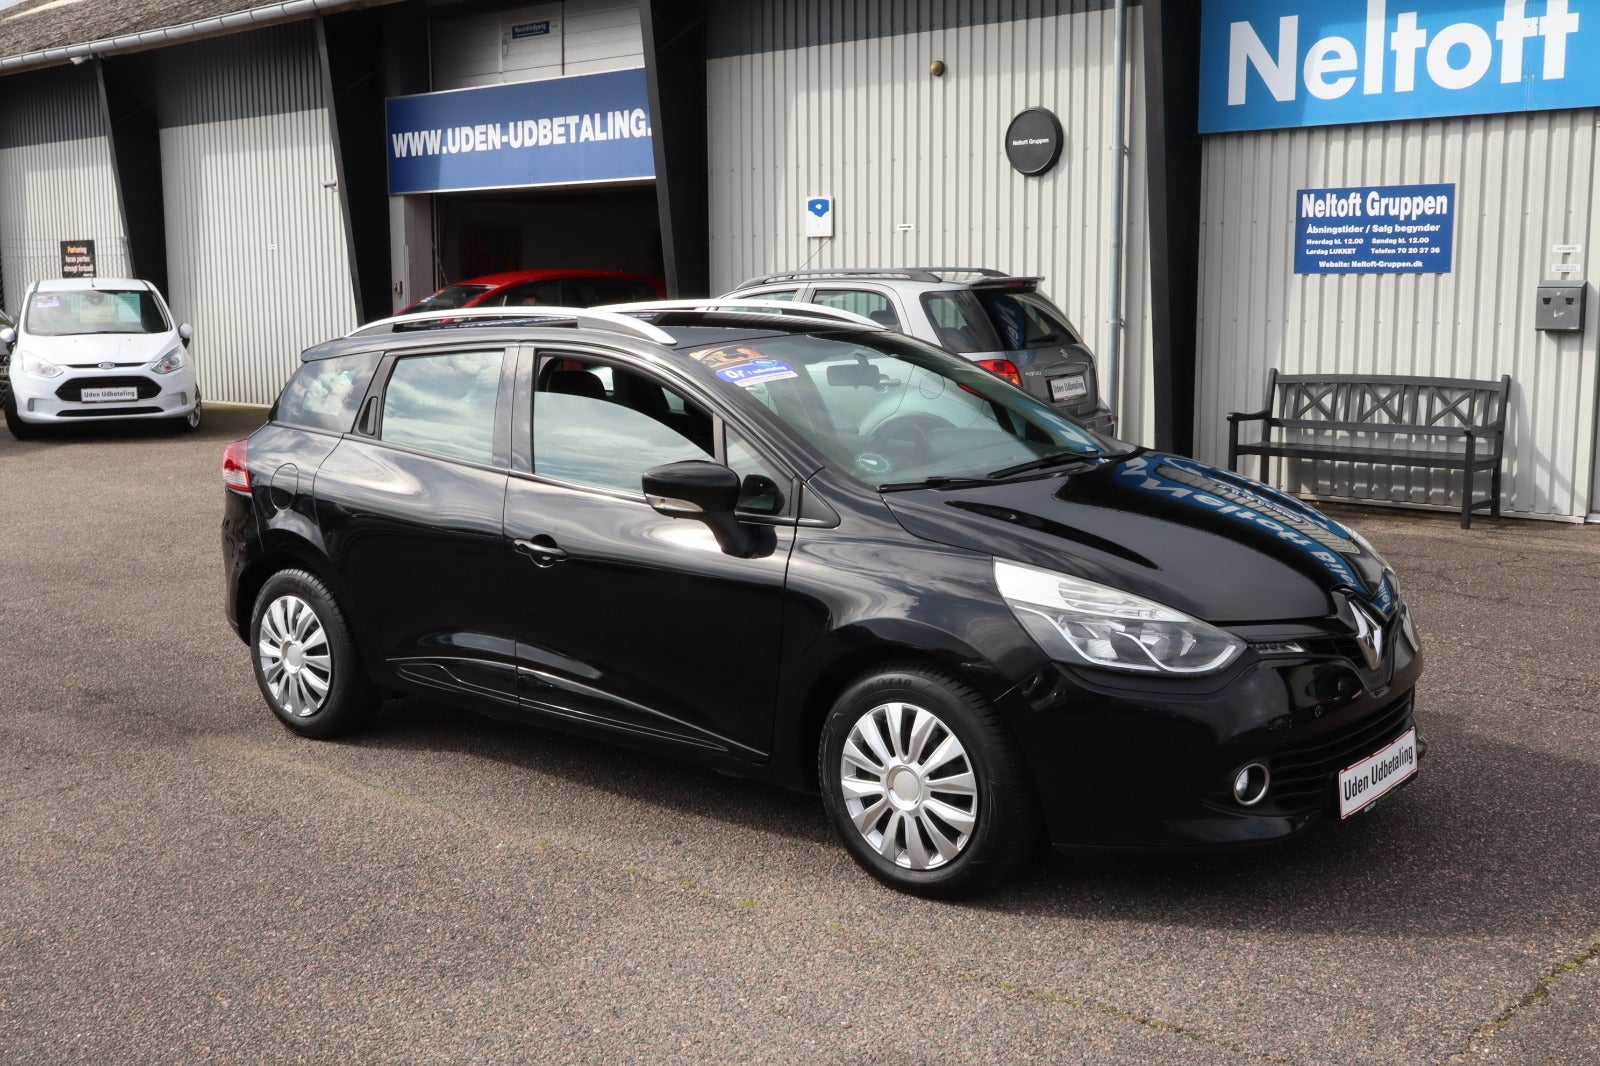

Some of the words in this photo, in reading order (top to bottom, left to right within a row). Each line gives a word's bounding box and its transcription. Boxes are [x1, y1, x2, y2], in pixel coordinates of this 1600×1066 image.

[1227, 0, 1580, 106] Neltoft
[1301, 192, 1362, 218] Neltoft
[1366, 190, 1448, 221] Gruppen
[1306, 223, 1364, 235] Åbningstider
[1372, 224, 1393, 234] Salg
[1394, 222, 1441, 234] begynder
[1318, 260, 1350, 268] Website:
[1351, 260, 1424, 269] Neltoft-Gruppen.dk
[1343, 774, 1369, 801] Uden
[1371, 745, 1413, 786] Udbetaling
